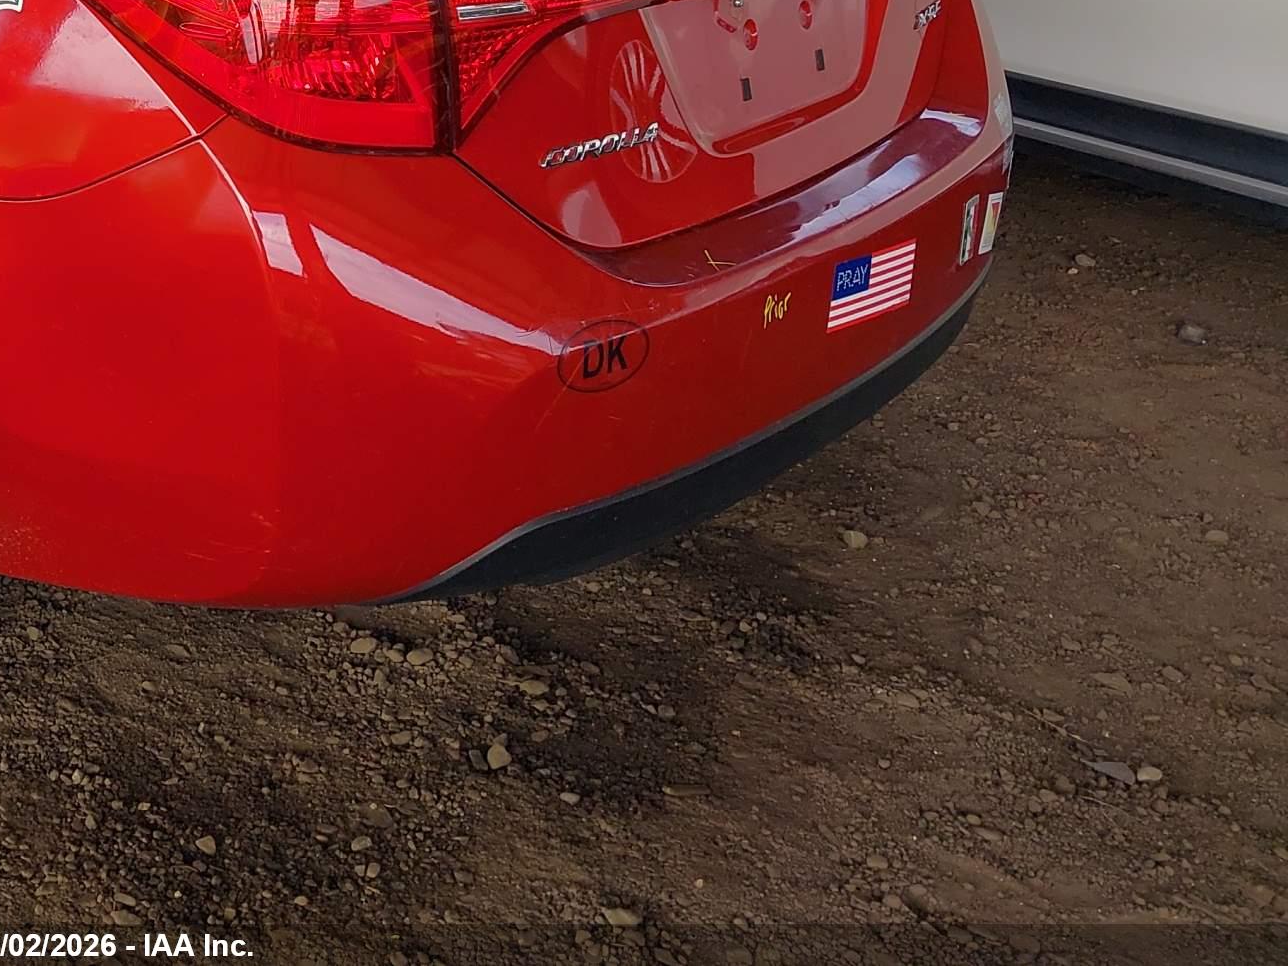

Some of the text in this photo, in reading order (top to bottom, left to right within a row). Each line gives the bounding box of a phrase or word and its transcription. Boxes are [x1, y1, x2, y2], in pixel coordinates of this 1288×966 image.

[539, 122, 659, 168] COROLLA
[836, 263, 869, 292] PRAY
[583, 334, 628, 379] DK
